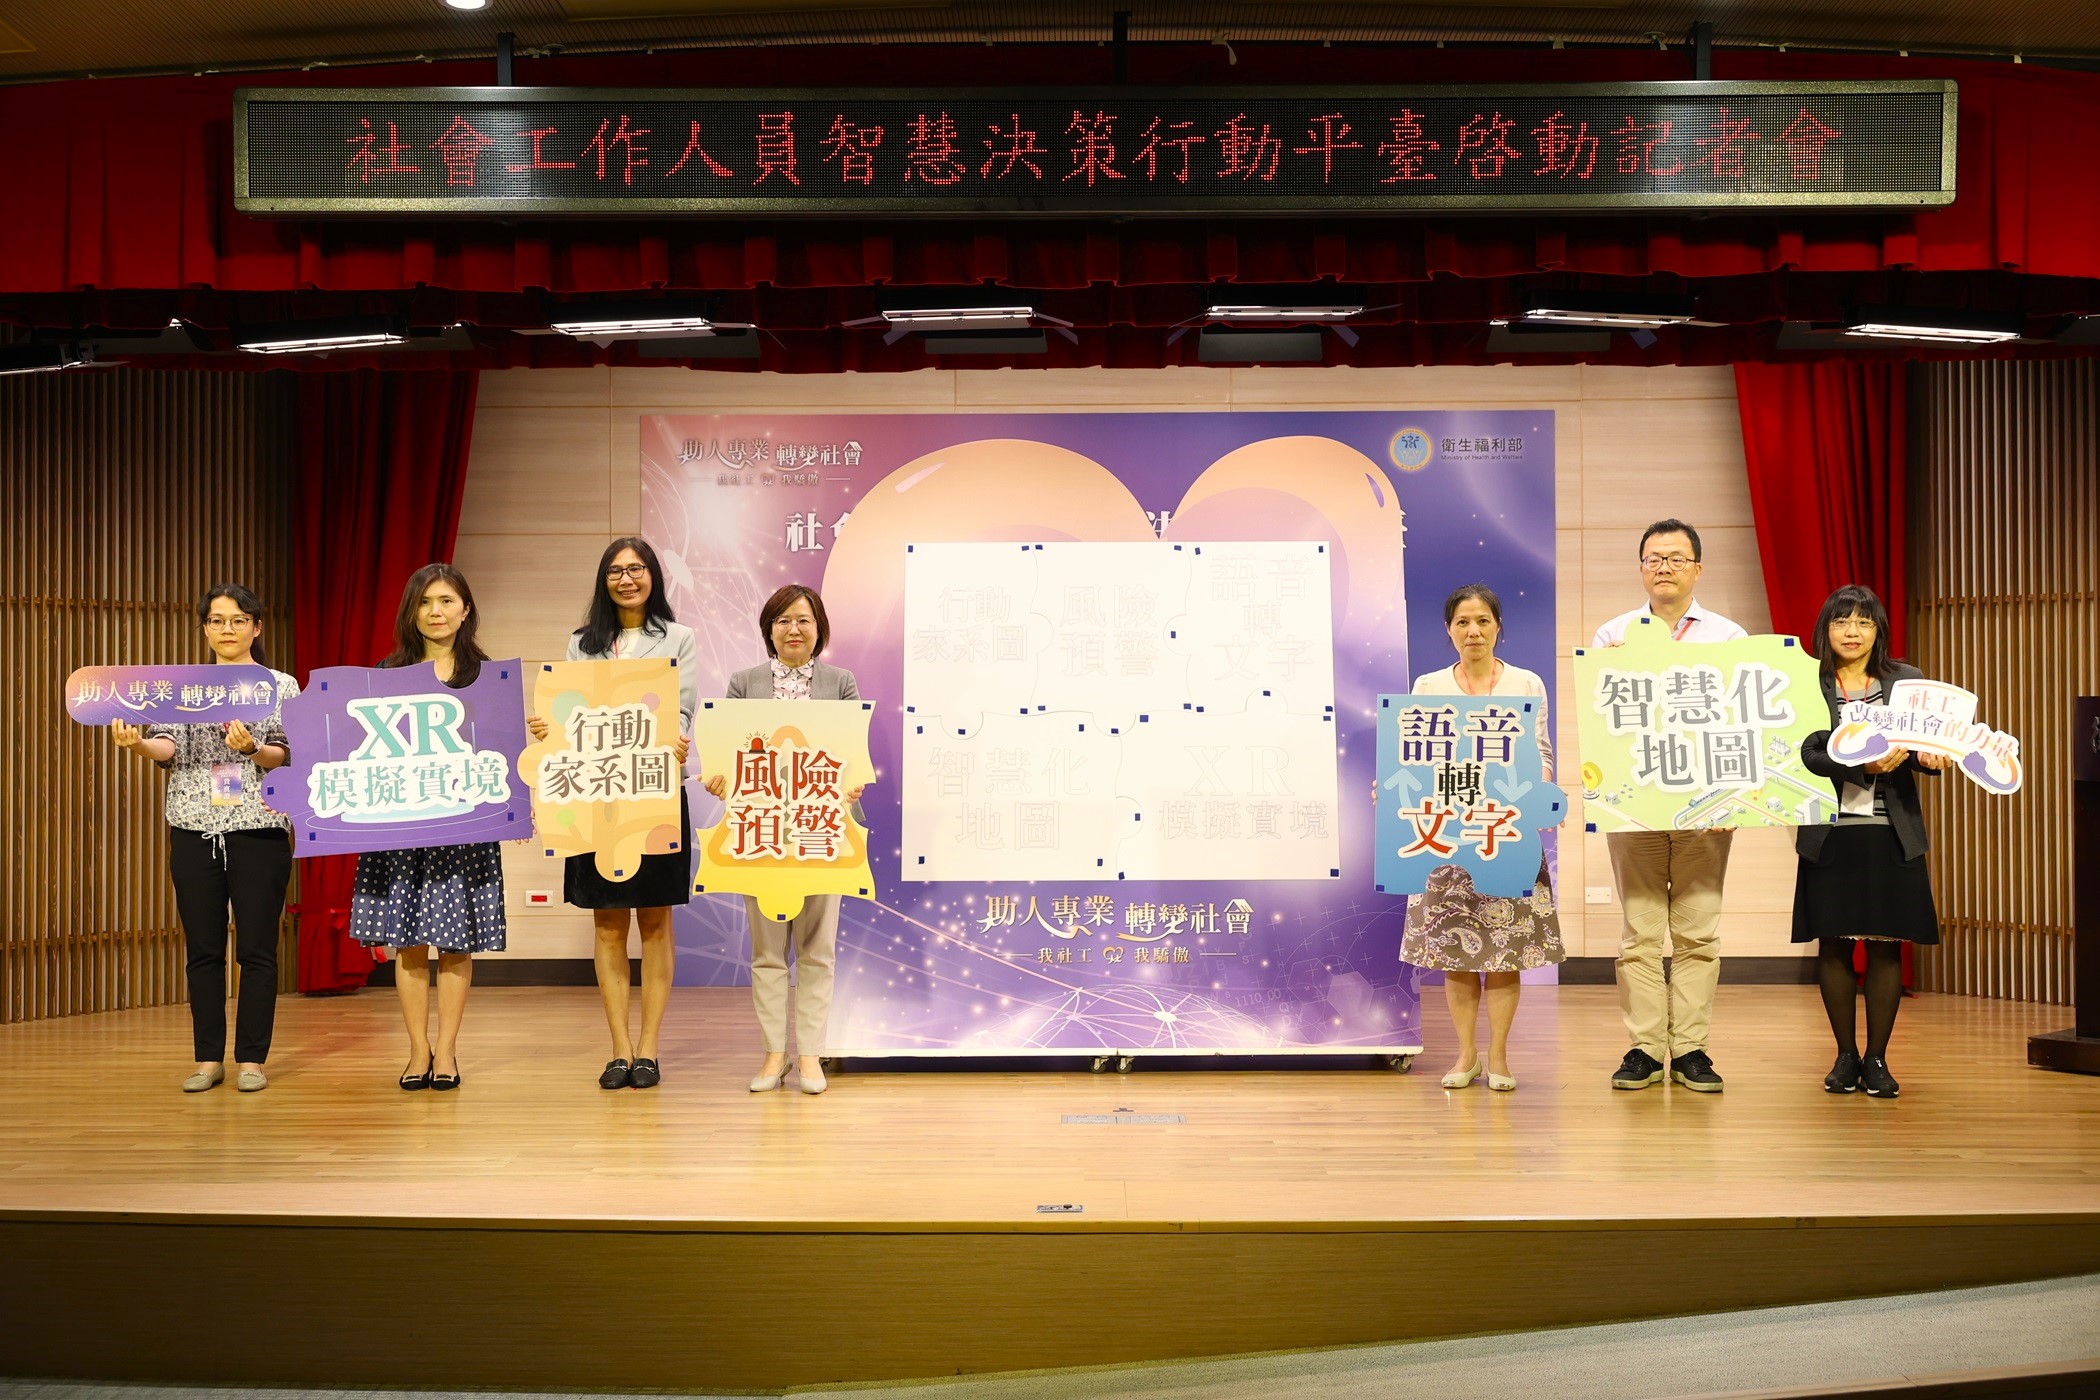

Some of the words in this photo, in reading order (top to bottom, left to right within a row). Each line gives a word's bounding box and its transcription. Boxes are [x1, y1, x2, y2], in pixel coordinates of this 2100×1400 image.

[677, 440, 770, 469] 助人專業
[772, 441, 864, 471] 轉變社會
[1441, 437, 1523, 453] 衛生福利部
[71, 679, 173, 711] 助人專業
[174, 681, 274, 712] 轉變社會
[1601, 669, 1789, 730] 智慧化
[1908, 689, 1957, 715] 社工
[354, 700, 468, 762] XR
[572, 709, 651, 753] 行動
[1402, 708, 1520, 764] 語音
[1850, 703, 2014, 761] 改變社會的力量
[544, 752, 671, 798] 家系圖
[731, 750, 843, 801] 風險
[1637, 728, 1757, 786] 地圖
[315, 757, 505, 812] 模擬實境
[1438, 762, 1481, 806] 轉
[730, 803, 842, 858] 預警
[1402, 800, 1522, 857] 文字
[976, 895, 1115, 940] 助人專業
[1116, 898, 1255, 942] 轉變社會
[1038, 947, 1093, 964] 我社工
[1134, 946, 1191, 965] 我驕傲
